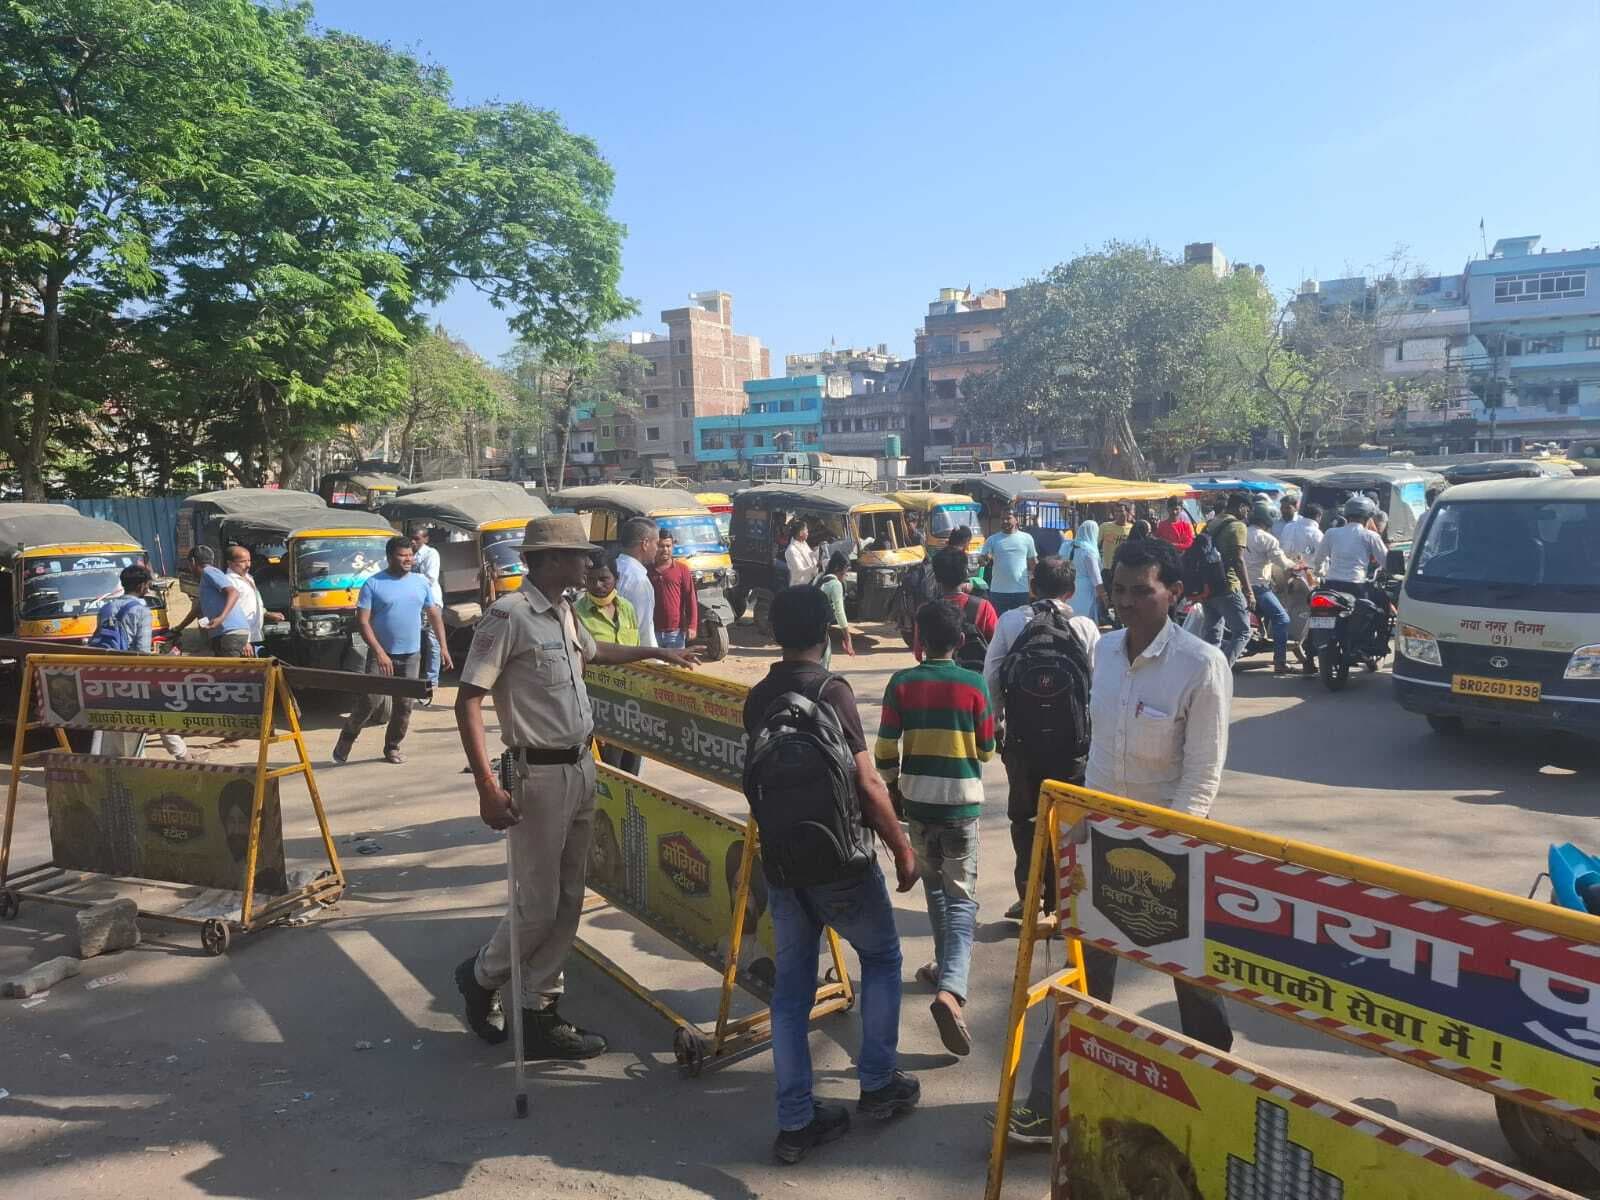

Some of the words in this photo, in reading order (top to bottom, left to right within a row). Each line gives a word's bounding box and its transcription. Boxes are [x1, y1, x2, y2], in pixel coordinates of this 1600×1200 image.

[83, 679, 151, 700] गया
[158, 673, 264, 711] पुलिस
[1212, 951, 1337, 1012] आपकी
[1346, 991, 1428, 1043] सेवा
[1437, 1019, 1474, 1060] में
[1490, 1041, 1503, 1071] !
[1214, 875, 1474, 989] गया
[1510, 959, 1600, 1062] पु
[1079, 1036, 1138, 1077] सौजन्य
[1142, 1061, 1169, 1089] से:
